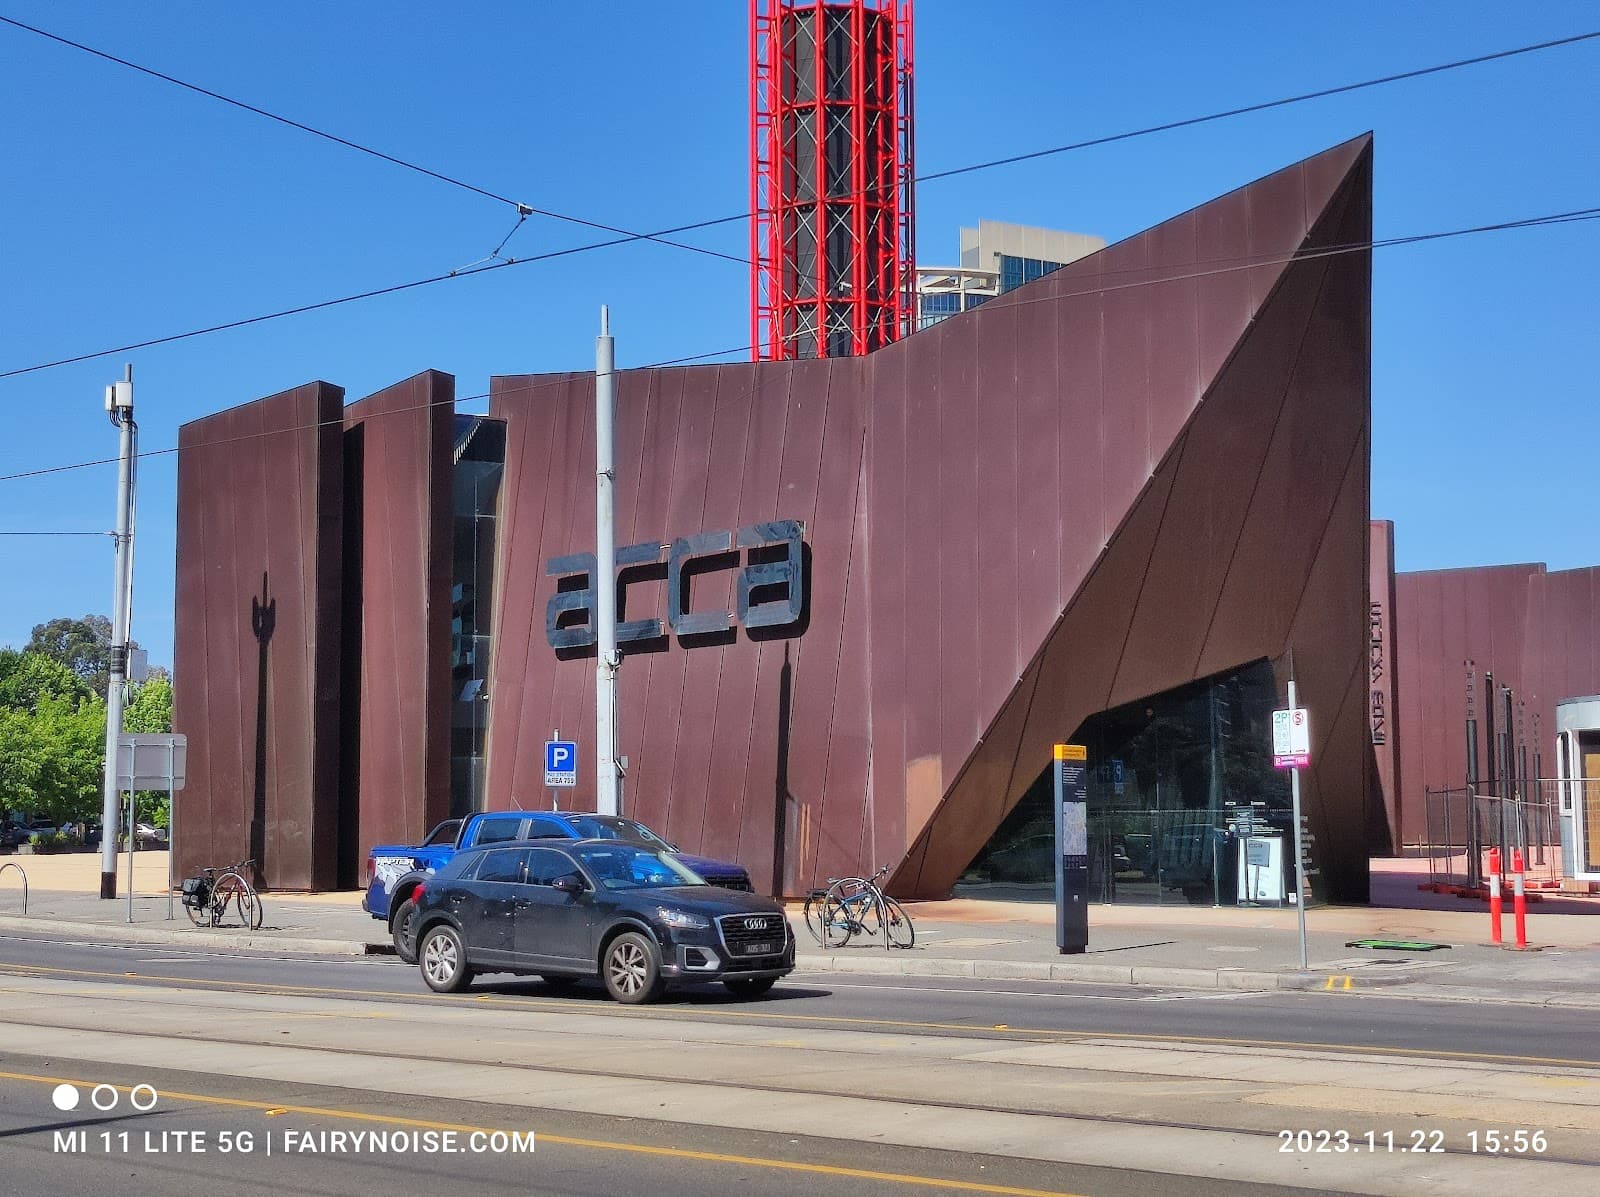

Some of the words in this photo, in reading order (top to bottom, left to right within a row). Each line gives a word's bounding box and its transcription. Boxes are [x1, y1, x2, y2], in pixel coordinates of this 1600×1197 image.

[545, 519, 804, 649] acca
[1274, 712, 1288, 723] 2P
[553, 747, 569, 768] P
